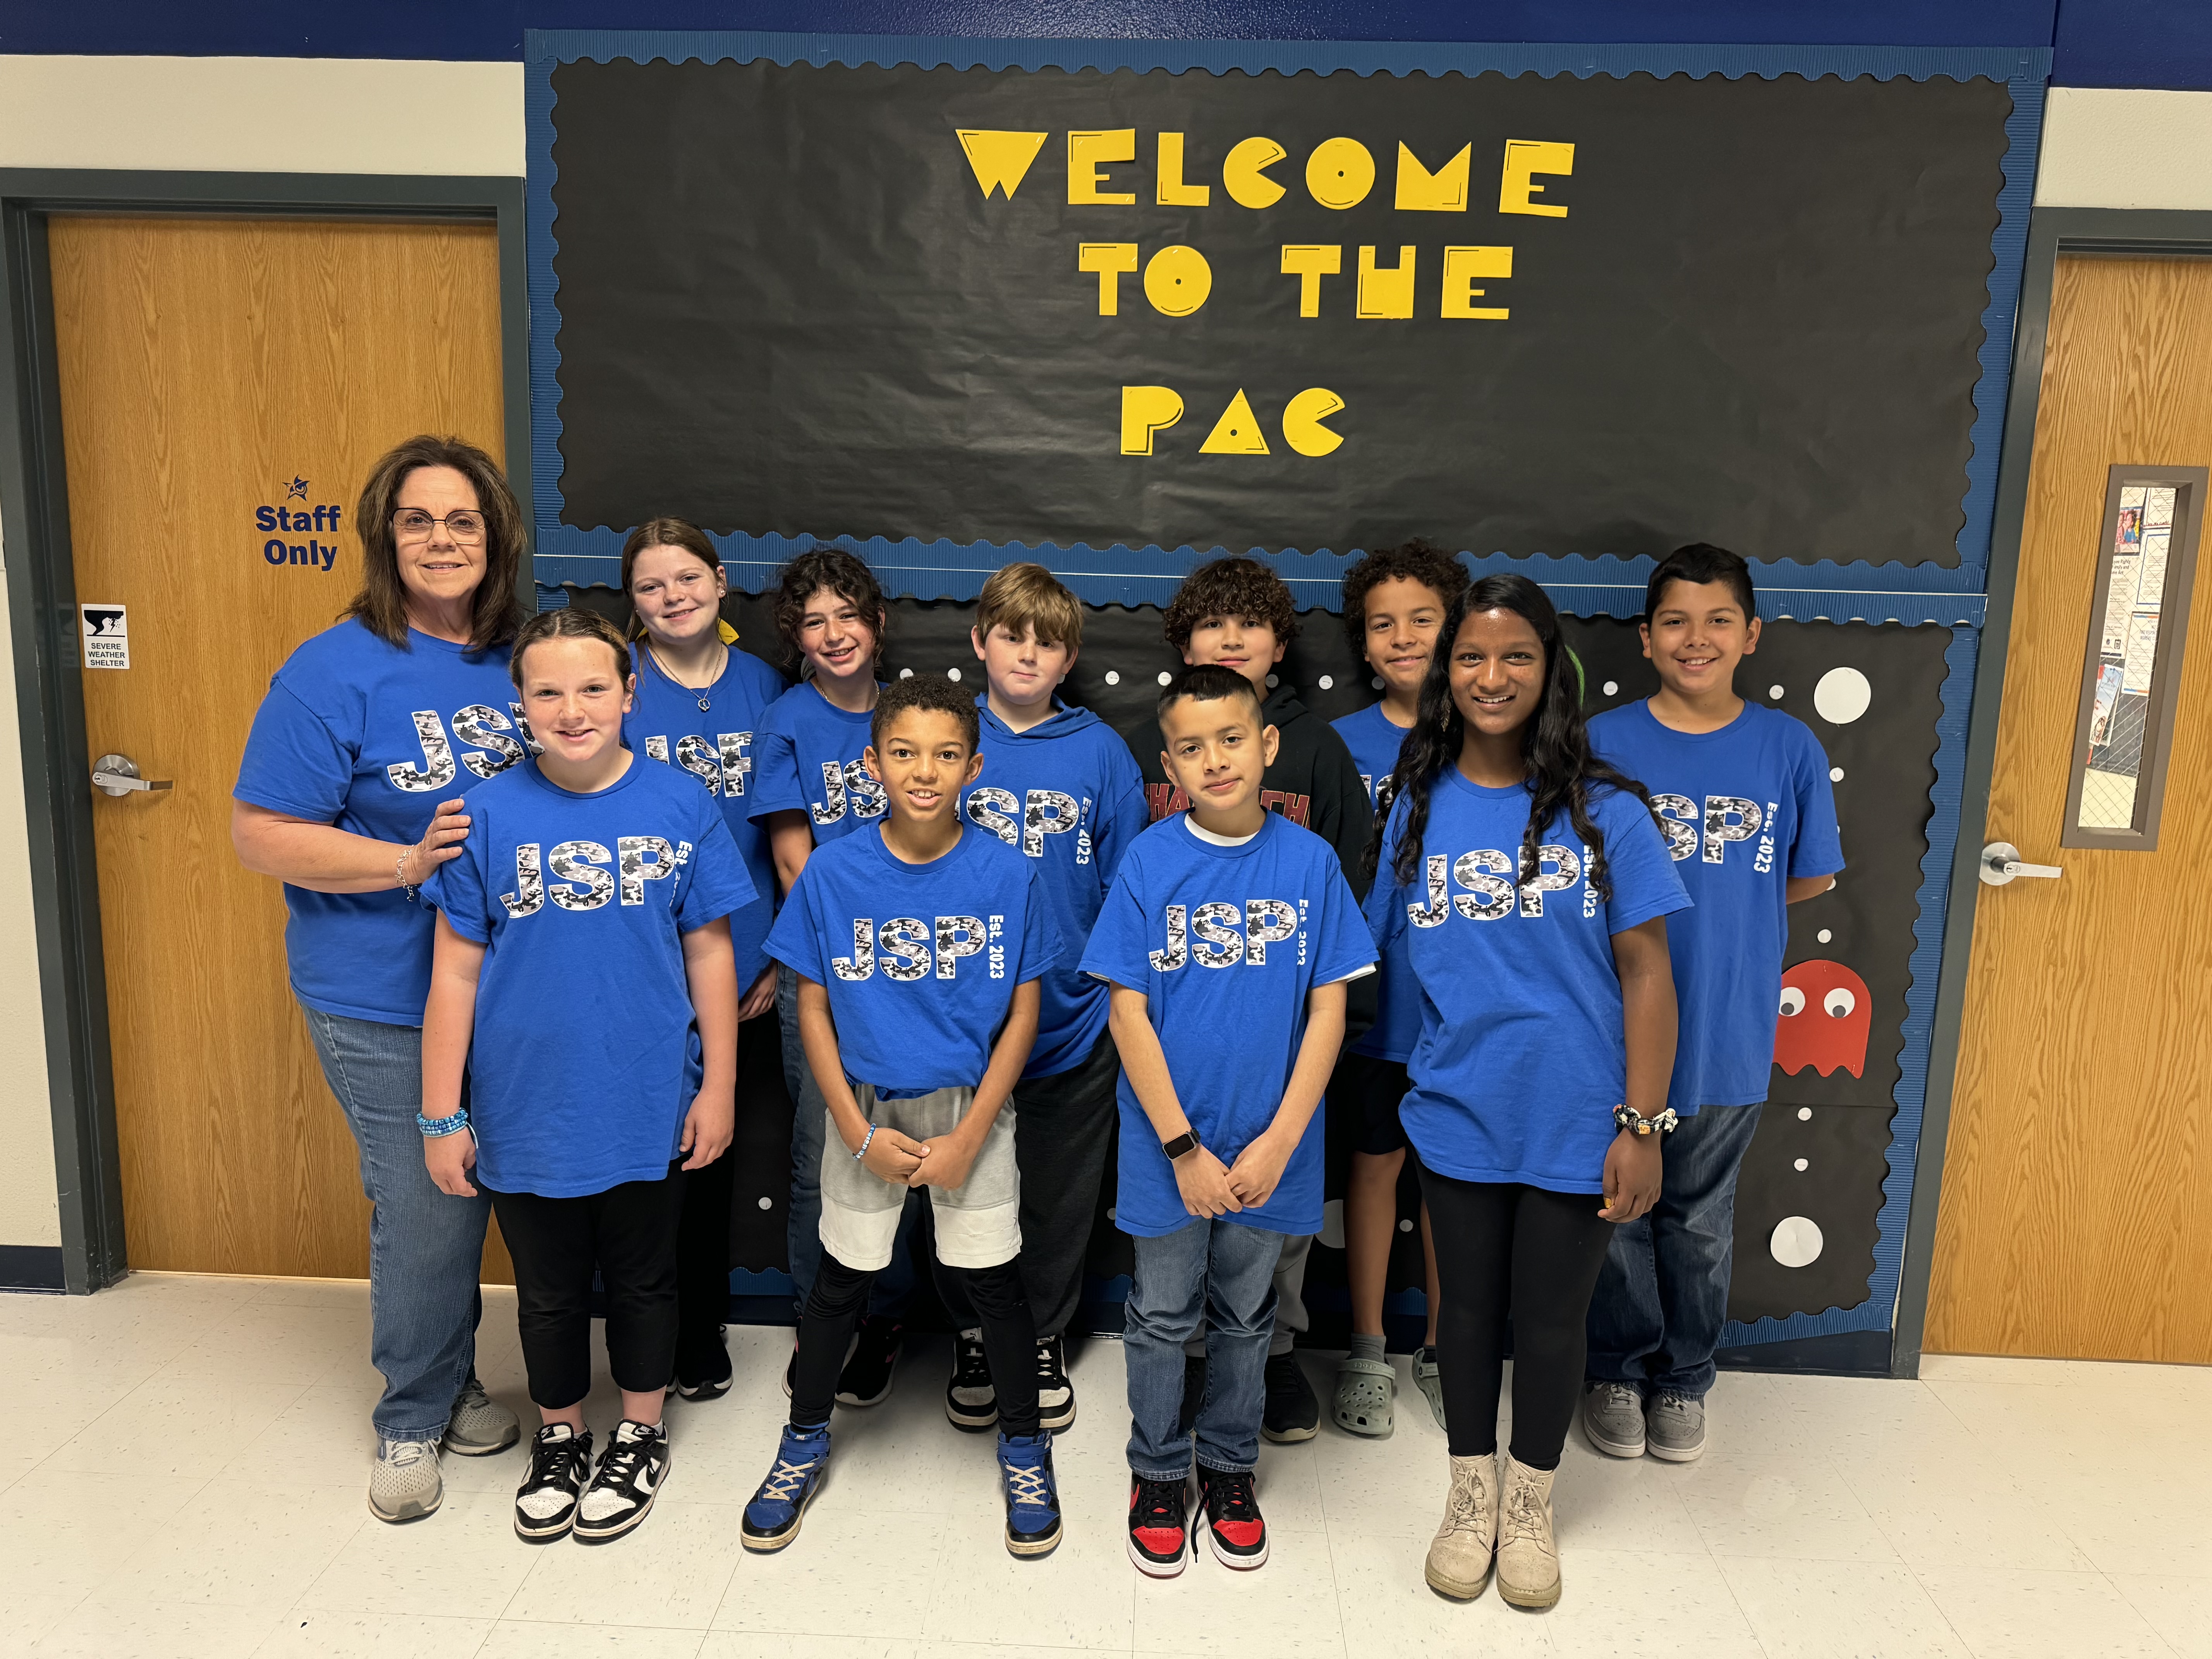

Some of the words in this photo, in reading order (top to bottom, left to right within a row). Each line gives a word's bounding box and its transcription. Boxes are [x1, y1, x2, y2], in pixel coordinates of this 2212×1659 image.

[955, 128, 1575, 217] WELCOME
[1079, 243, 1212, 317] TO
[1281, 244, 1513, 319] THE
[1121, 386, 1345, 457] PAC
[256, 505, 341, 532] Staff
[264, 539, 338, 571] Only
[387, 702, 544, 792] JS
[812, 759, 888, 824] JS
[955, 787, 1079, 857] SP
[675, 840, 692, 869] Est
[1076, 829, 1091, 865] 2023
[1649, 793, 1762, 864] SP
[1753, 835, 1774, 873] 2023
[500, 836, 674, 919] JSP
[1407, 844, 1580, 928] JSP
[831, 915, 987, 981] JSP
[989, 915, 1004, 943] Est.
[989, 945, 1005, 979] 2023
[1149, 899, 1297, 972] JSP
[639, 1425, 652, 1434] NIKE
